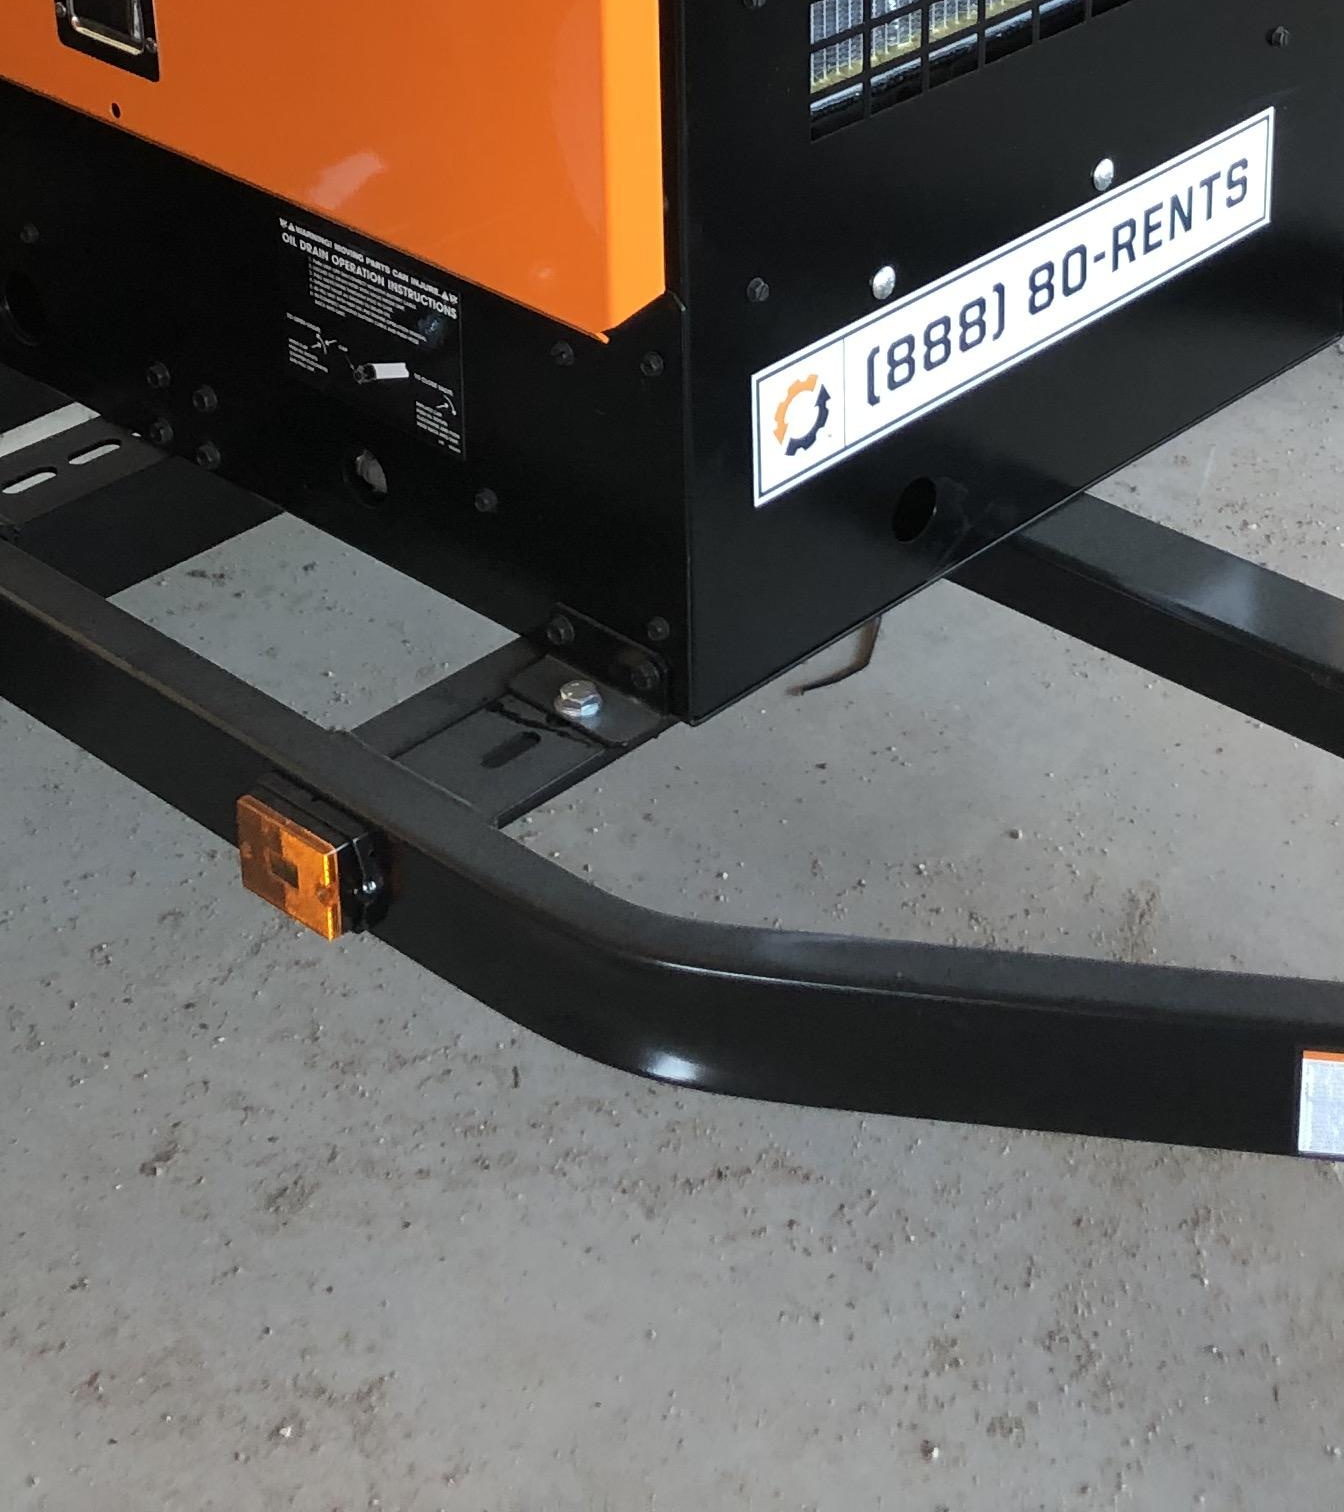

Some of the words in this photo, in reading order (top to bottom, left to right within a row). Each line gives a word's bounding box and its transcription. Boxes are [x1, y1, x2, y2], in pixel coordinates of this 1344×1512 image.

[282, 232, 297, 248] OIL
[299, 239, 329, 262] DRAIN
[331, 254, 385, 287] OPERATION
[387, 279, 457, 320] INSTRUCTIONS
[866, 284, 1005, 405] (888)
[1028, 157, 1249, 315] 80-RENTS
